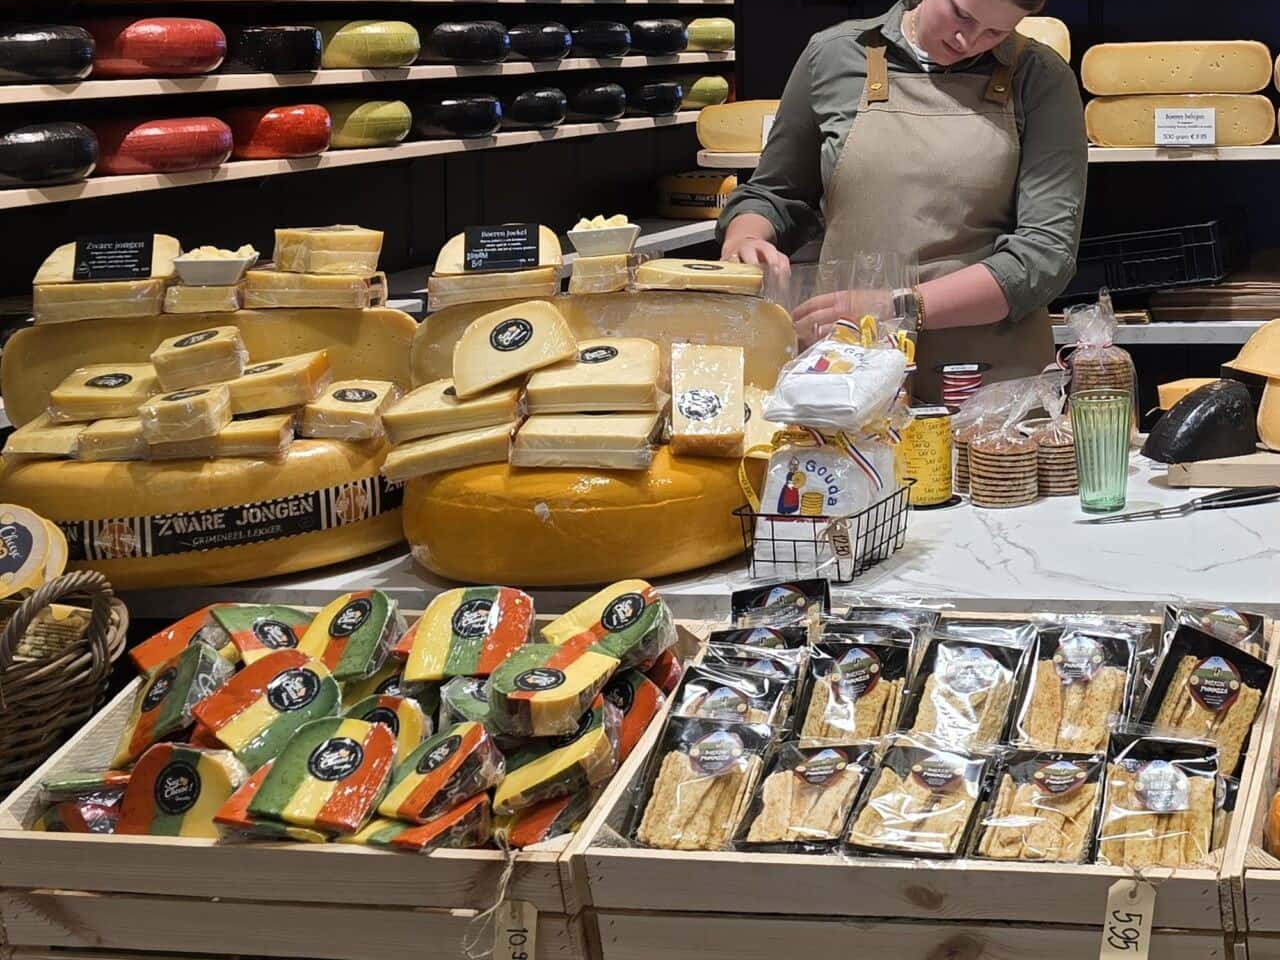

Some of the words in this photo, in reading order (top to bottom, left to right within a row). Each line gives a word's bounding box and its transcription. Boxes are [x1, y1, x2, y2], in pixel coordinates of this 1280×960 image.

[154, 513, 226, 538] ZWARE
[236, 498, 315, 526] JONGEN
[1107, 910, 1143, 953] 5.95
